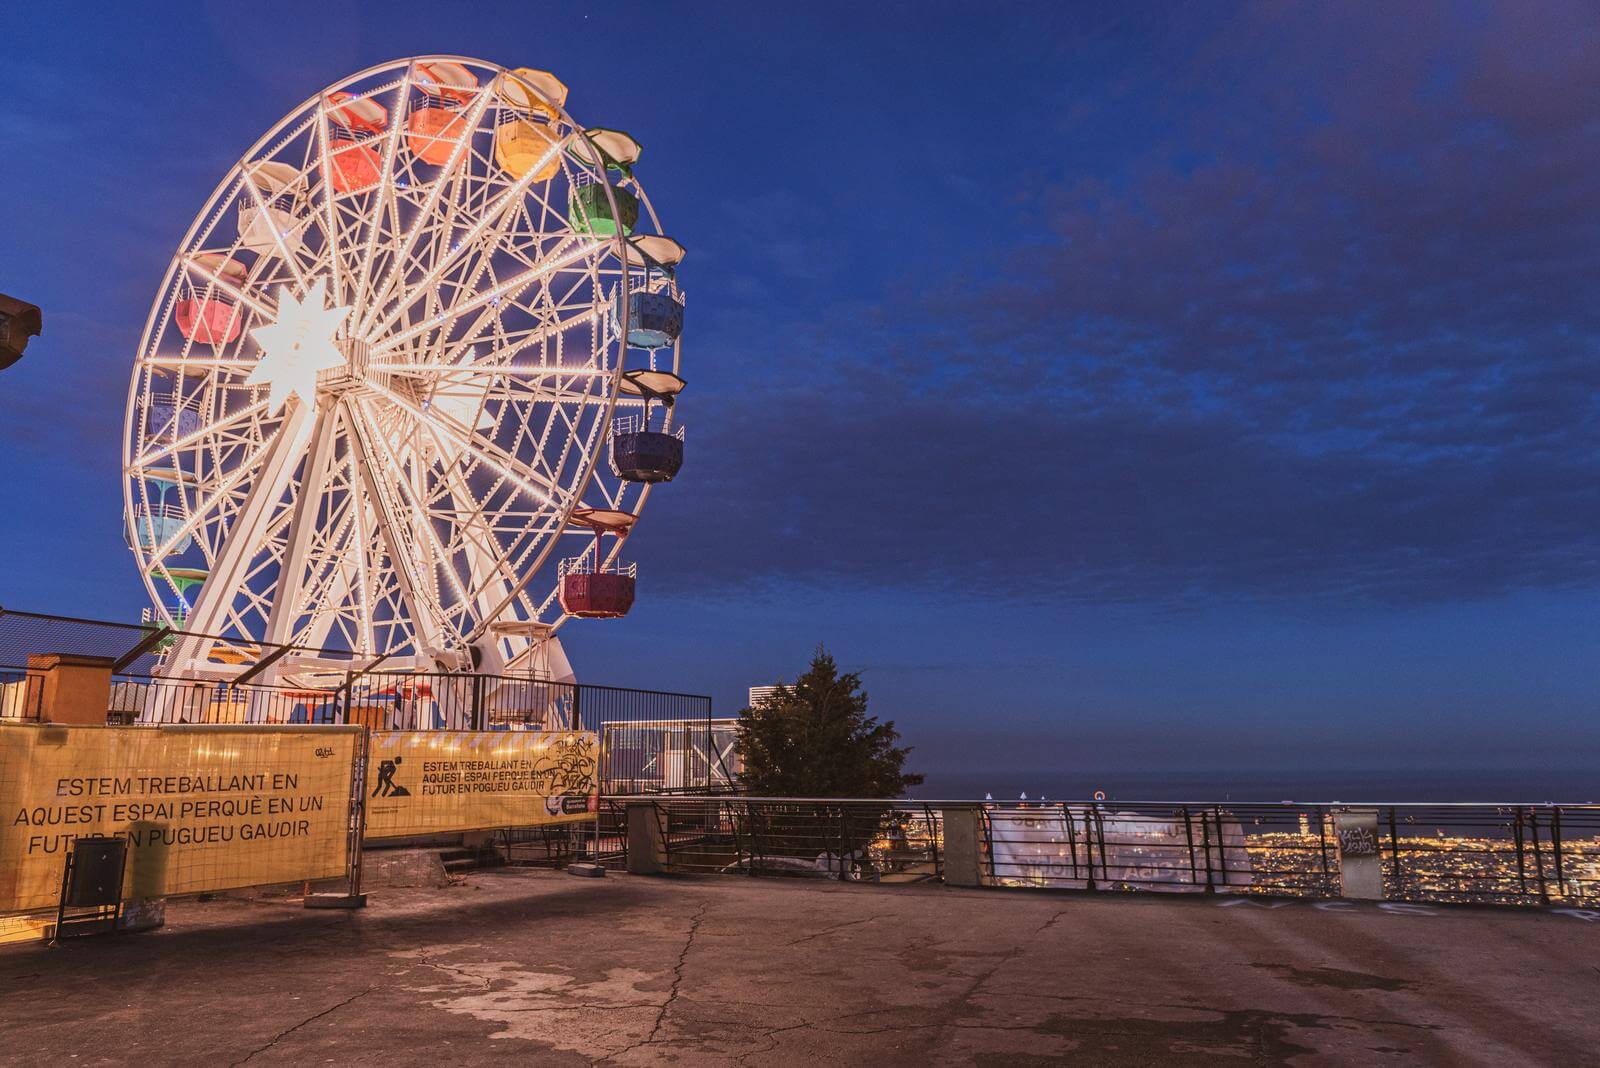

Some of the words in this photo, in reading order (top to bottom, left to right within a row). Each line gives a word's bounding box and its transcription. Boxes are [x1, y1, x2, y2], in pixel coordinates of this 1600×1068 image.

[423, 761, 458, 772] ESTEM
[460, 760, 518, 771] TREBALLANT
[520, 760, 532, 769] EN
[56, 777, 132, 797] ESTEM
[137, 774, 266, 794] TREBALLANT
[272, 774, 298, 790] EN
[422, 772, 461, 783] AQUEST
[464, 771, 490, 782] ESPAI
[422, 783, 456, 795] FUTUR
[458, 782, 470, 793] EN
[472, 781, 510, 792] POGUEU
[512, 780, 545, 791] GAUDIR
[14, 804, 107, 826] AQUEST
[113, 803, 174, 822] ESPAI
[180, 796, 262, 818] PERQUÈ
[268, 798, 294, 814] EN
[300, 796, 323, 812] UN
[28, 833, 104, 854] FUT
[148, 825, 234, 847] PUGUEU
[240, 820, 309, 840] GAUDIR
